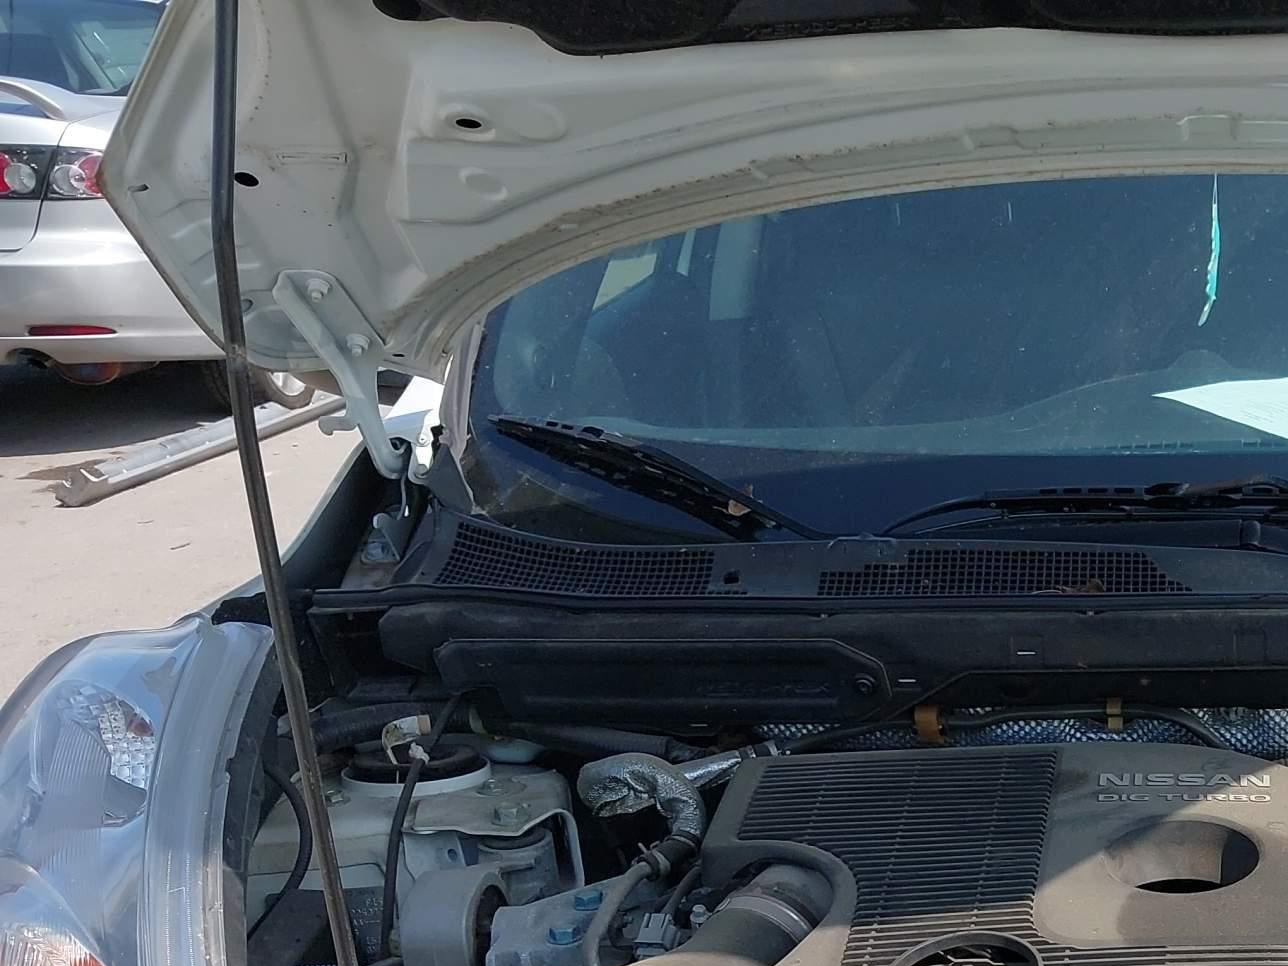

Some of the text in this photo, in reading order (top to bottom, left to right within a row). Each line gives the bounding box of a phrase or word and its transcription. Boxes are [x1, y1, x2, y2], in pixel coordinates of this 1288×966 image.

[1099, 773, 1271, 788] NISSAN
[1098, 793, 1271, 803] DIG TURBO
